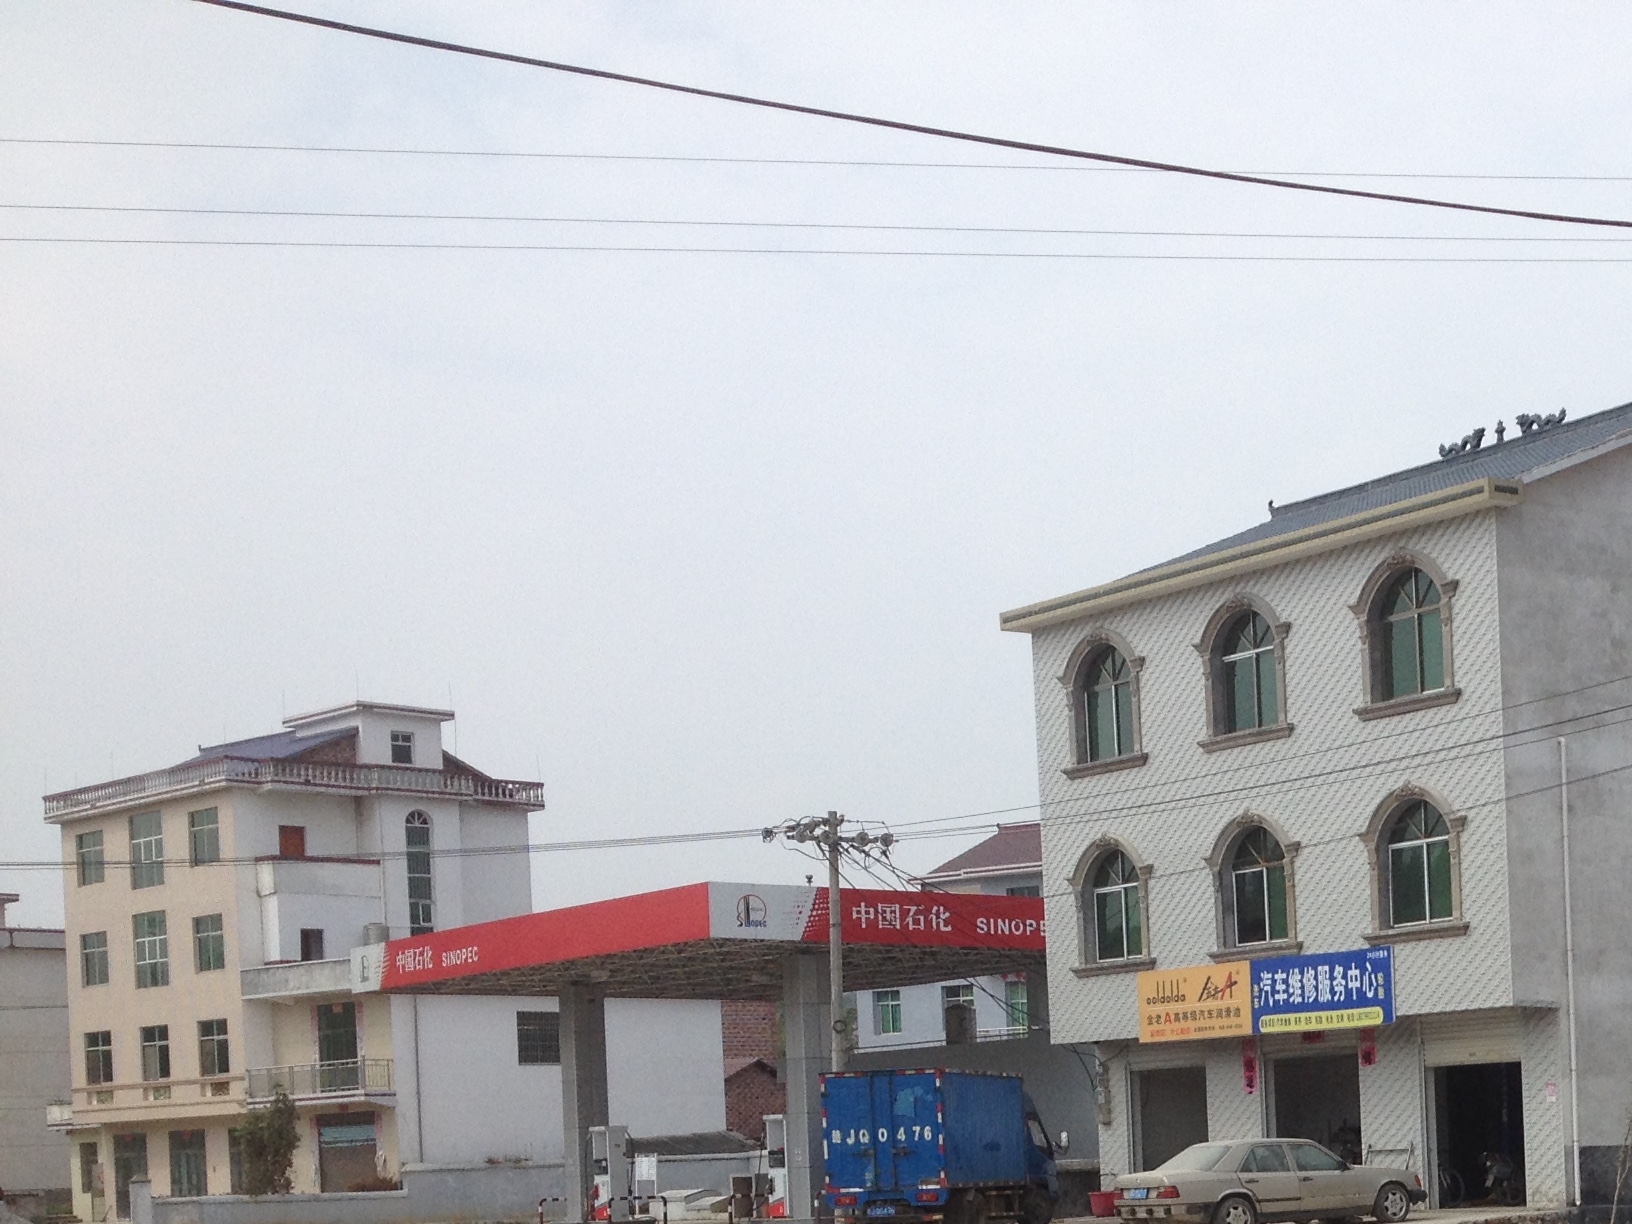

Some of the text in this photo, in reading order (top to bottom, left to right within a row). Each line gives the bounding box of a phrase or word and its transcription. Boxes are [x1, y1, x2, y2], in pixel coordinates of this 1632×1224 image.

[852, 902, 952, 932] 中国石化
[396, 946, 479, 974] 中国石化 SINOPEC
[1260, 961, 1376, 1008] 汽车维修服务中心
